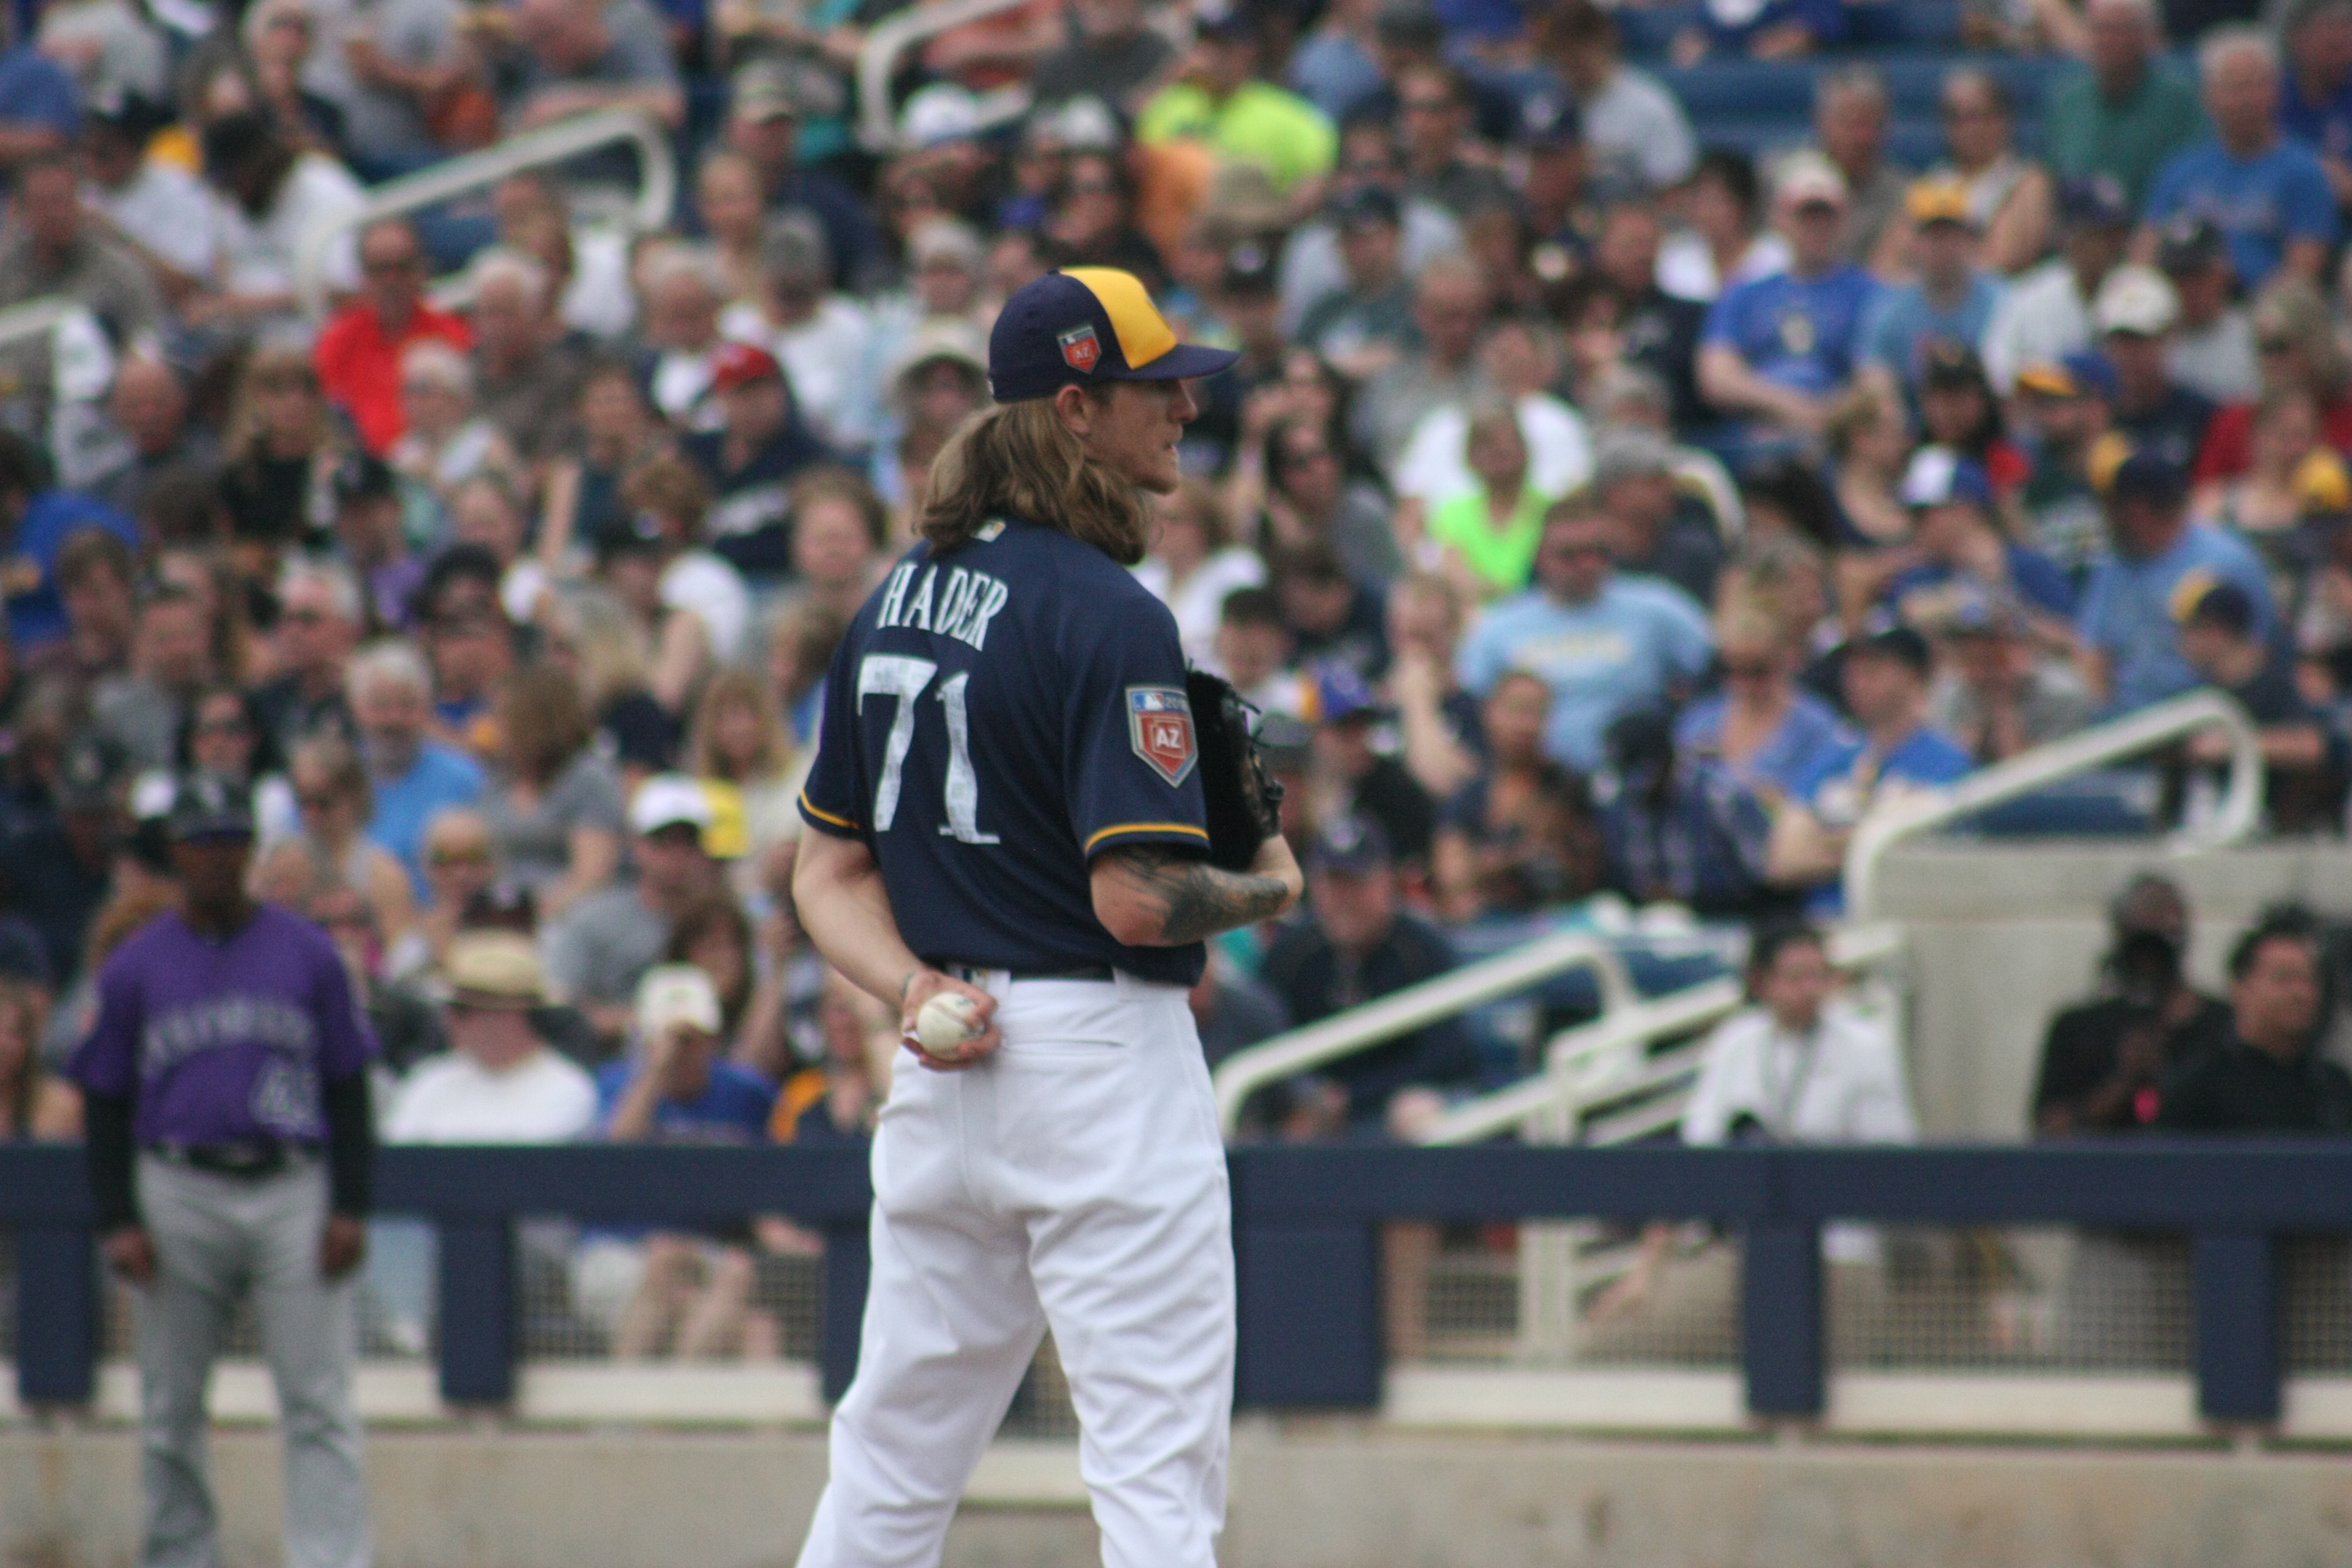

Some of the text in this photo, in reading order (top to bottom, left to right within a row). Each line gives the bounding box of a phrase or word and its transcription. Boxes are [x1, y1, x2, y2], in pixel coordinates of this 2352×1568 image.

[876, 562, 1008, 652] HADER
[857, 654, 1000, 845] 71
[1156, 726, 1182, 749] AZ
